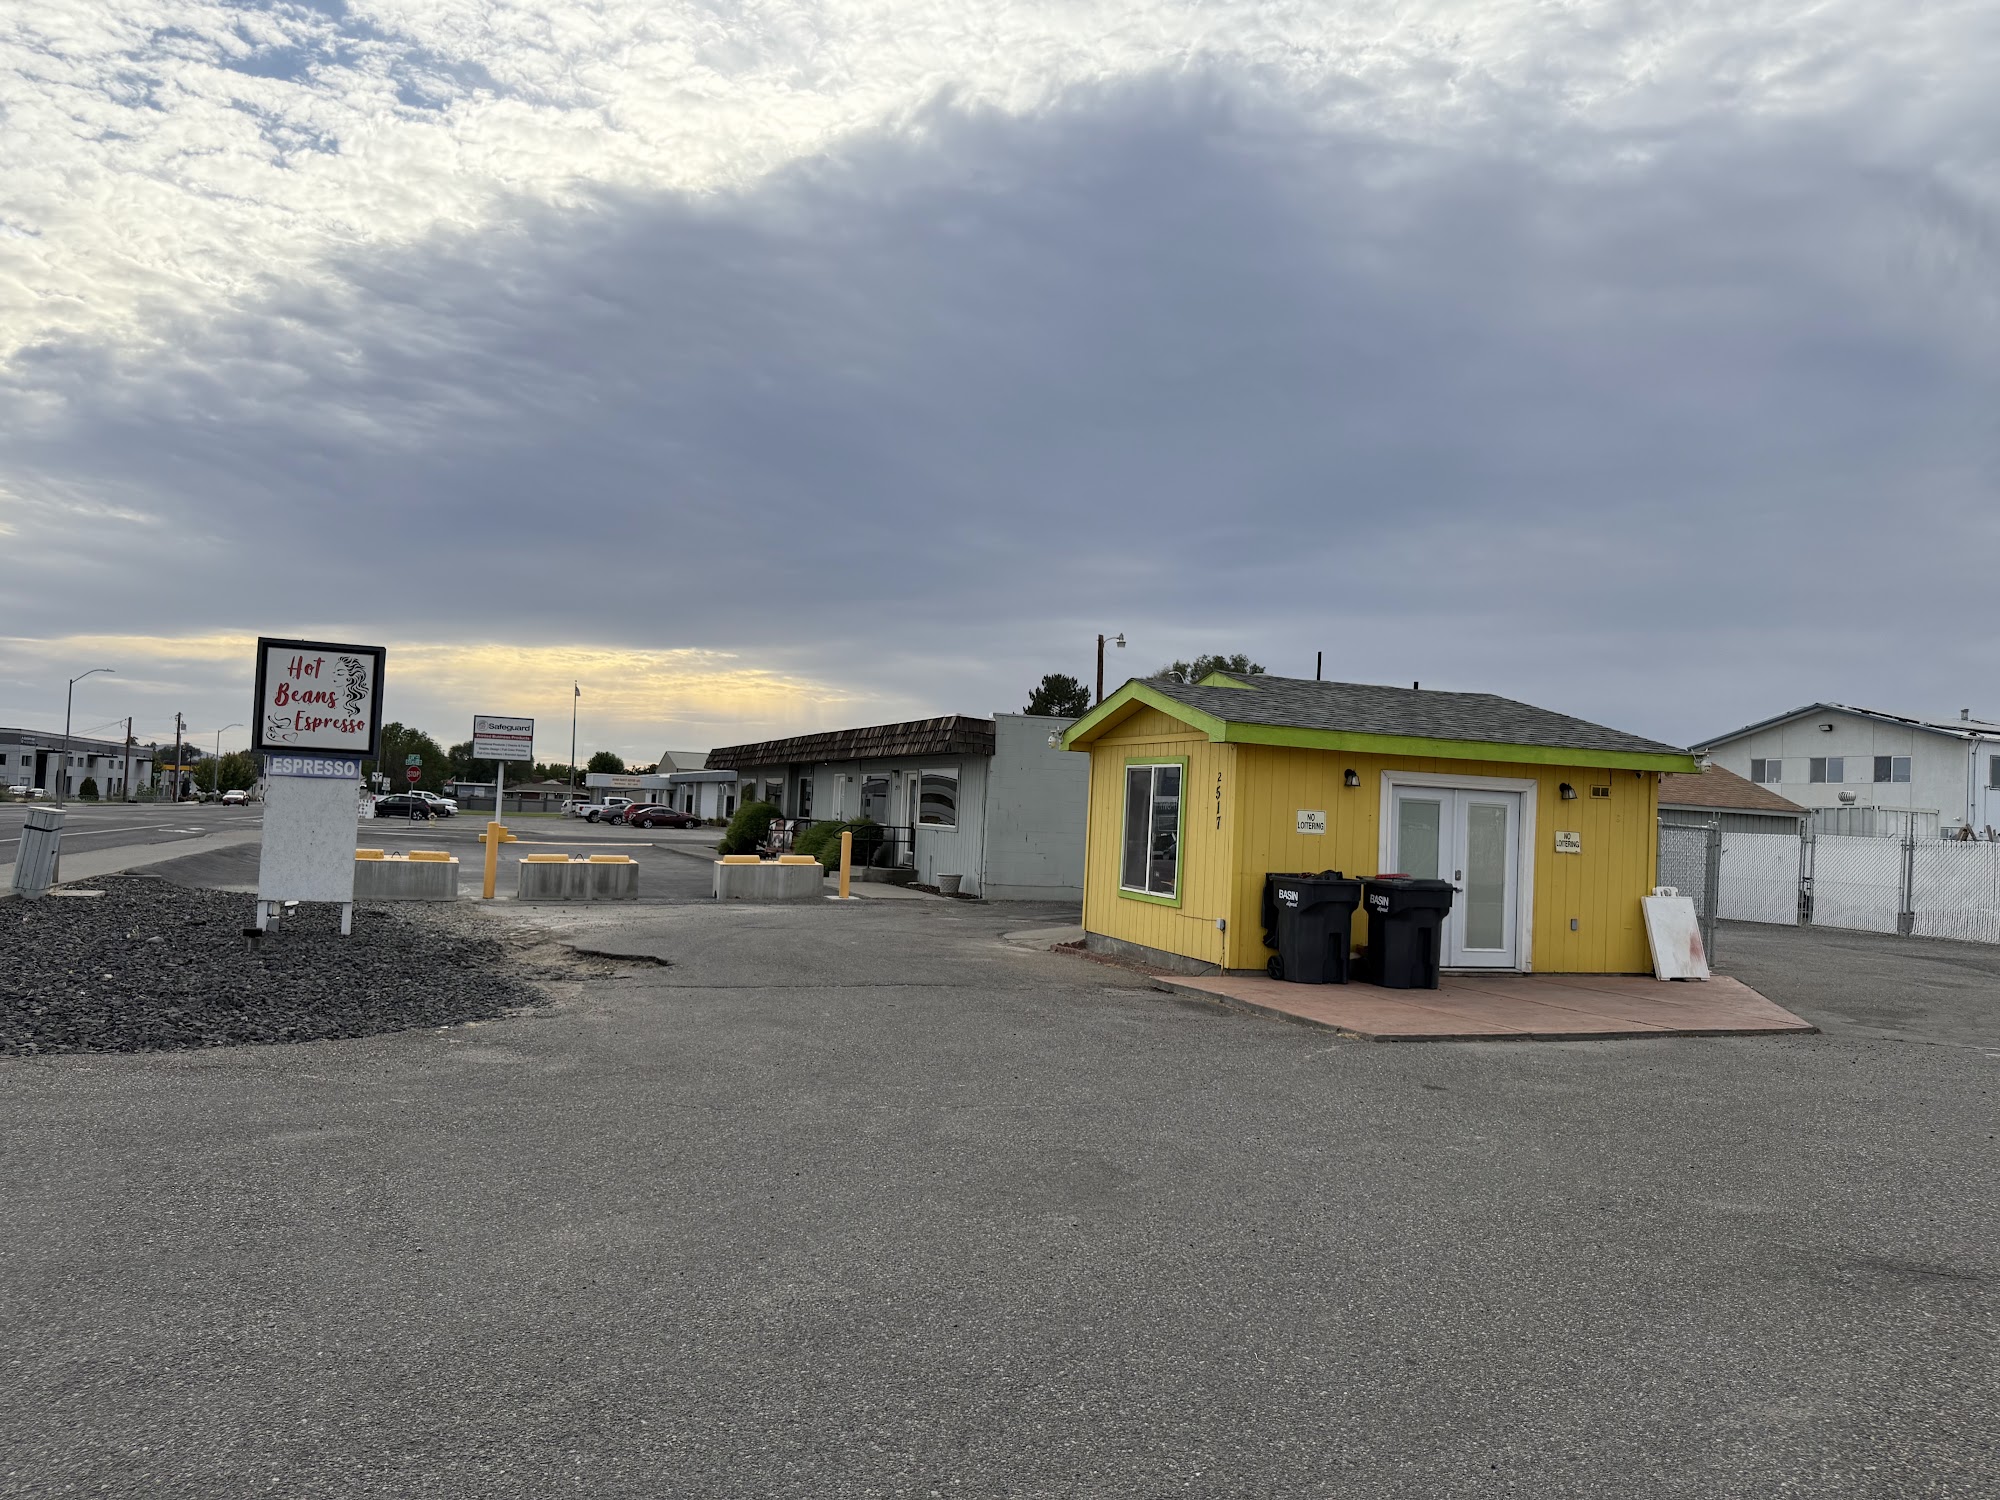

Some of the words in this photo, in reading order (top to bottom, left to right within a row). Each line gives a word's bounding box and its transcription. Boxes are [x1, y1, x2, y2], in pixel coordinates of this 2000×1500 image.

[287, 655, 325, 680] Hot
[274, 682, 338, 709] Beans
[294, 710, 365, 734] Espresso
[489, 723, 530, 731] Safeguard
[272, 757, 356, 776] ESPRESSO
[407, 770, 420, 778] STOP
[1298, 822, 1324, 830] LOITERING
[1557, 840, 1579, 848] LOITERING
[1279, 889, 1298, 901] BASIN
[1370, 894, 1389, 906] BASIN
